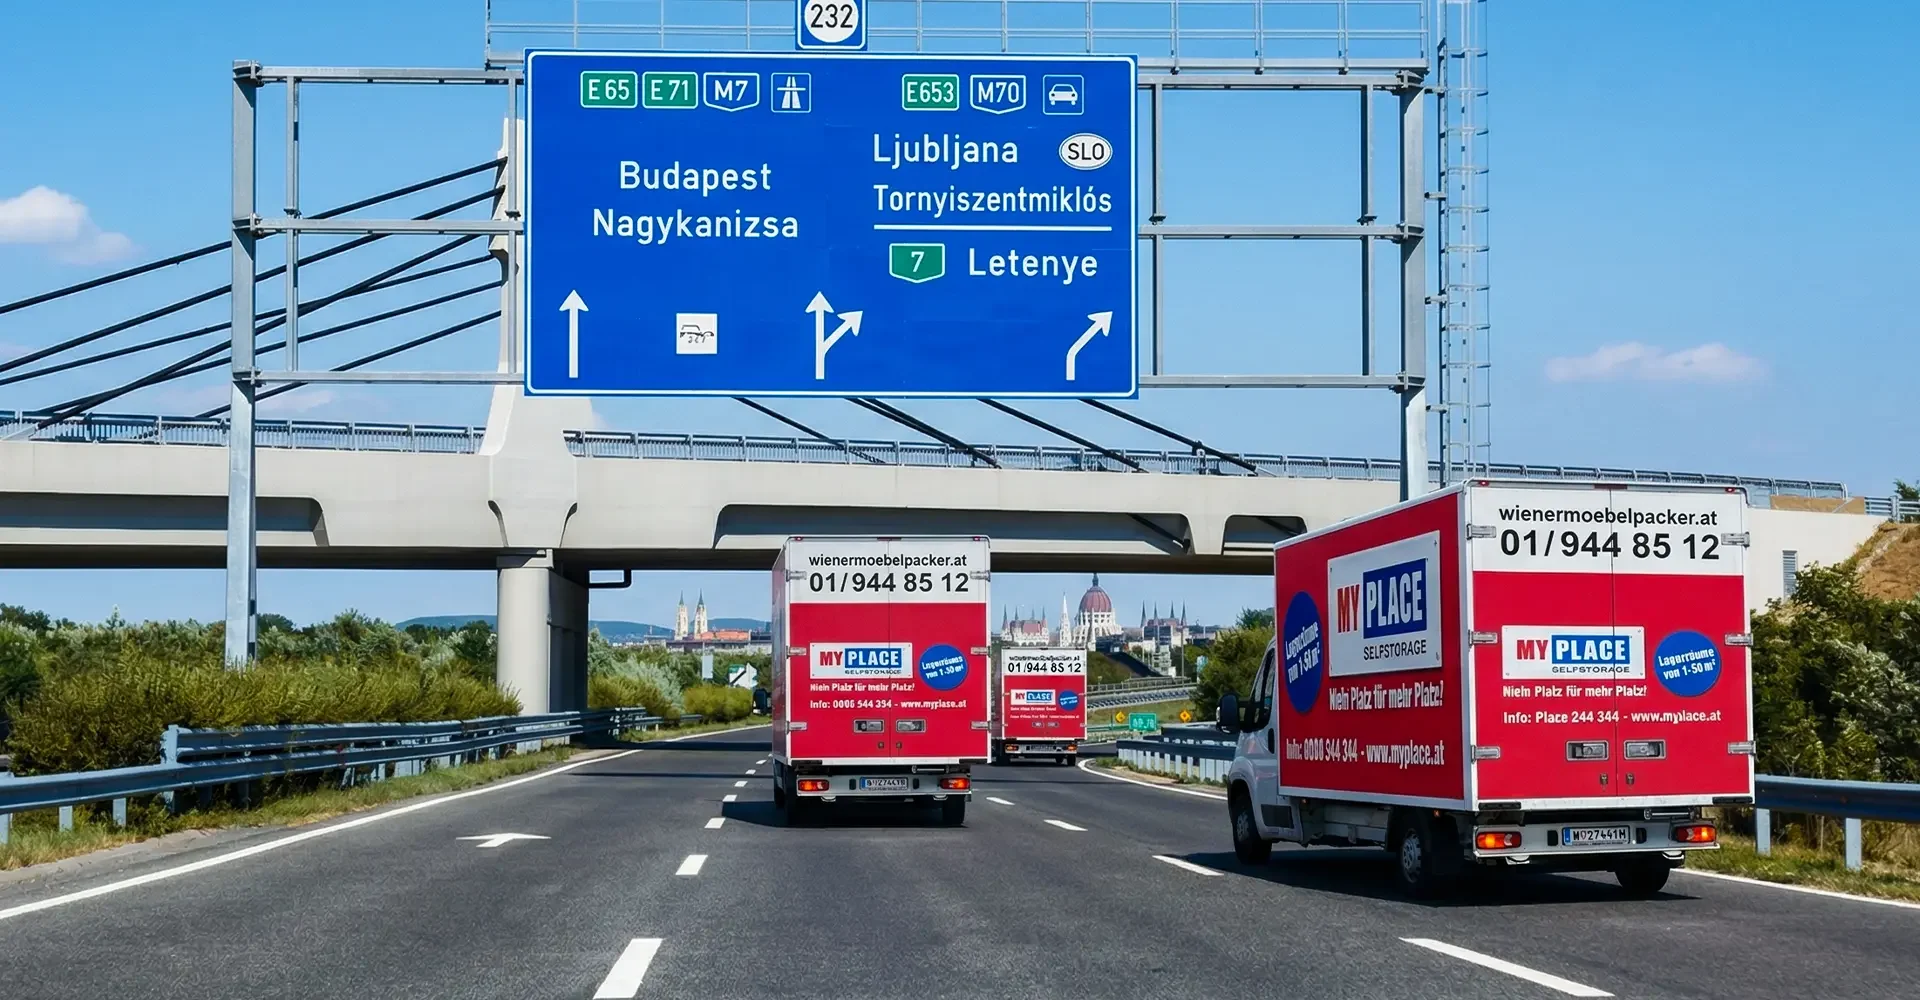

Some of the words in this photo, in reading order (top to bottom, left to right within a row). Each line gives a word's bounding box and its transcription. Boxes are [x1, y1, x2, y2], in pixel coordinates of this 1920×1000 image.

[810, 3, 853, 29] 232
[714, 80, 749, 101] M7
[907, 81, 954, 103] E653
[978, 81, 1020, 103] M70
[873, 133, 1018, 169] Ljubljana
[1067, 142, 1105, 161] SLO
[620, 160, 772, 198] Budapest
[873, 184, 1112, 218] Tornyiszentmiklós
[593, 208, 798, 245] Nagykanizsa
[910, 251, 925, 273] 7
[969, 248, 1098, 285] Letenye
[1499, 505, 1718, 526] wienermoebelpacker.at
[1632, 532, 1671, 559] 85
[1683, 533, 1720, 560] 12
[809, 553, 967, 569] wienermoebelpacker.at
[903, 572, 933, 593] 85
[941, 572, 969, 593] 12
[1337, 584, 1360, 633] MY
[1366, 570, 1423, 628] PLACE
[819, 651, 843, 666] MY
[847, 650, 900, 667] PLACE
[1516, 639, 1549, 660] MY
[1555, 639, 1626, 661] PLACE
[1067, 662, 1082, 673] 12
[1566, 685, 1583, 697] für
[1585, 685, 1613, 697] mehr
[1503, 710, 1532, 724] Info:
[1535, 711, 1569, 724] Place
[1571, 710, 1595, 723] 244
[1597, 710, 1620, 722] 344
